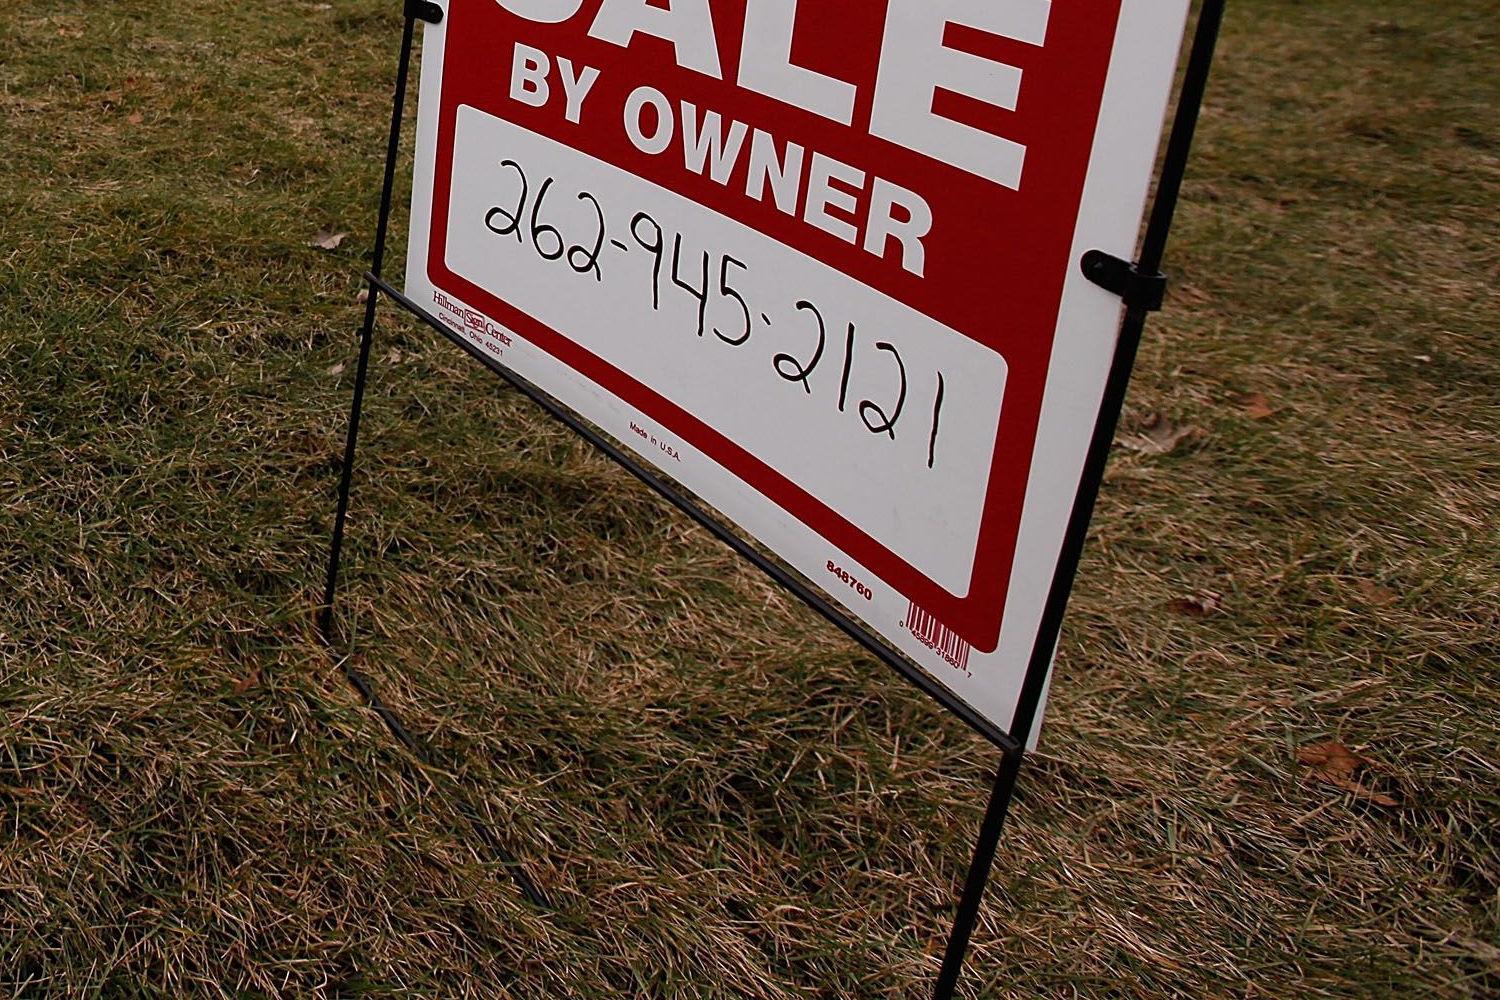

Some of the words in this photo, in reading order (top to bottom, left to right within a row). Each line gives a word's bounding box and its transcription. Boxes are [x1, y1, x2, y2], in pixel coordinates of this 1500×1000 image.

[509, 41, 602, 125] BY
[623, 85, 933, 279] OWNER
[433, 290, 464, 318] Hillman
[466, 312, 484, 330] Sign
[485, 322, 513, 347] Center
[469, 331, 483, 344] Ohio
[485, 341, 503, 356] 45231
[629, 421, 648, 439] Made
[650, 435, 657, 445] in
[660, 441, 681, 462] U.S.A.
[826, 559, 873, 600] 848760
